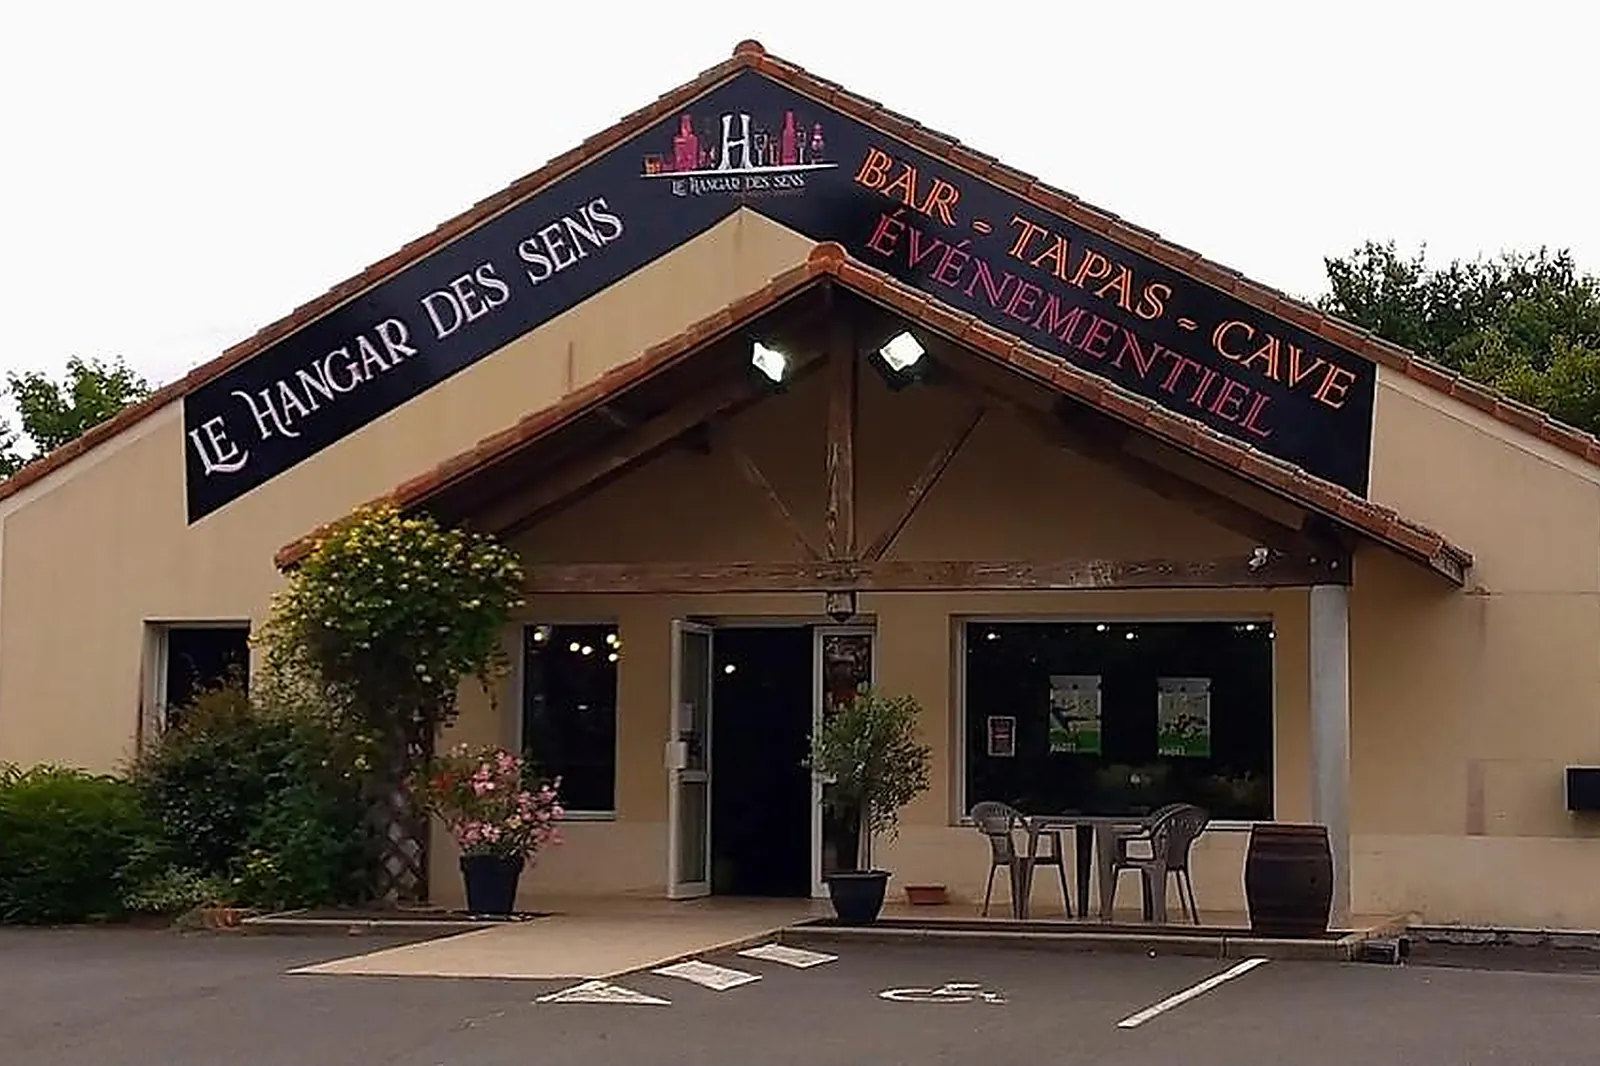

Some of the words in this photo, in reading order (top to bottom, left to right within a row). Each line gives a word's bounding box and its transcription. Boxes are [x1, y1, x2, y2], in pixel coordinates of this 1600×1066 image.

[672, 179, 687, 196] LE
[689, 176, 741, 196] HANGAR
[746, 175, 770, 190] DES
[854, 147, 961, 228] BAR
[1006, 215, 1172, 321] TAPAS
[1212, 320, 1357, 410] CAVE
[189, 416, 249, 477] LE
[231, 318, 419, 439] HANGAR
[421, 263, 510, 340] DES
[517, 197, 624, 286] SENS
[864, 209, 1275, 440] ÉVÉNEMENTIEL
